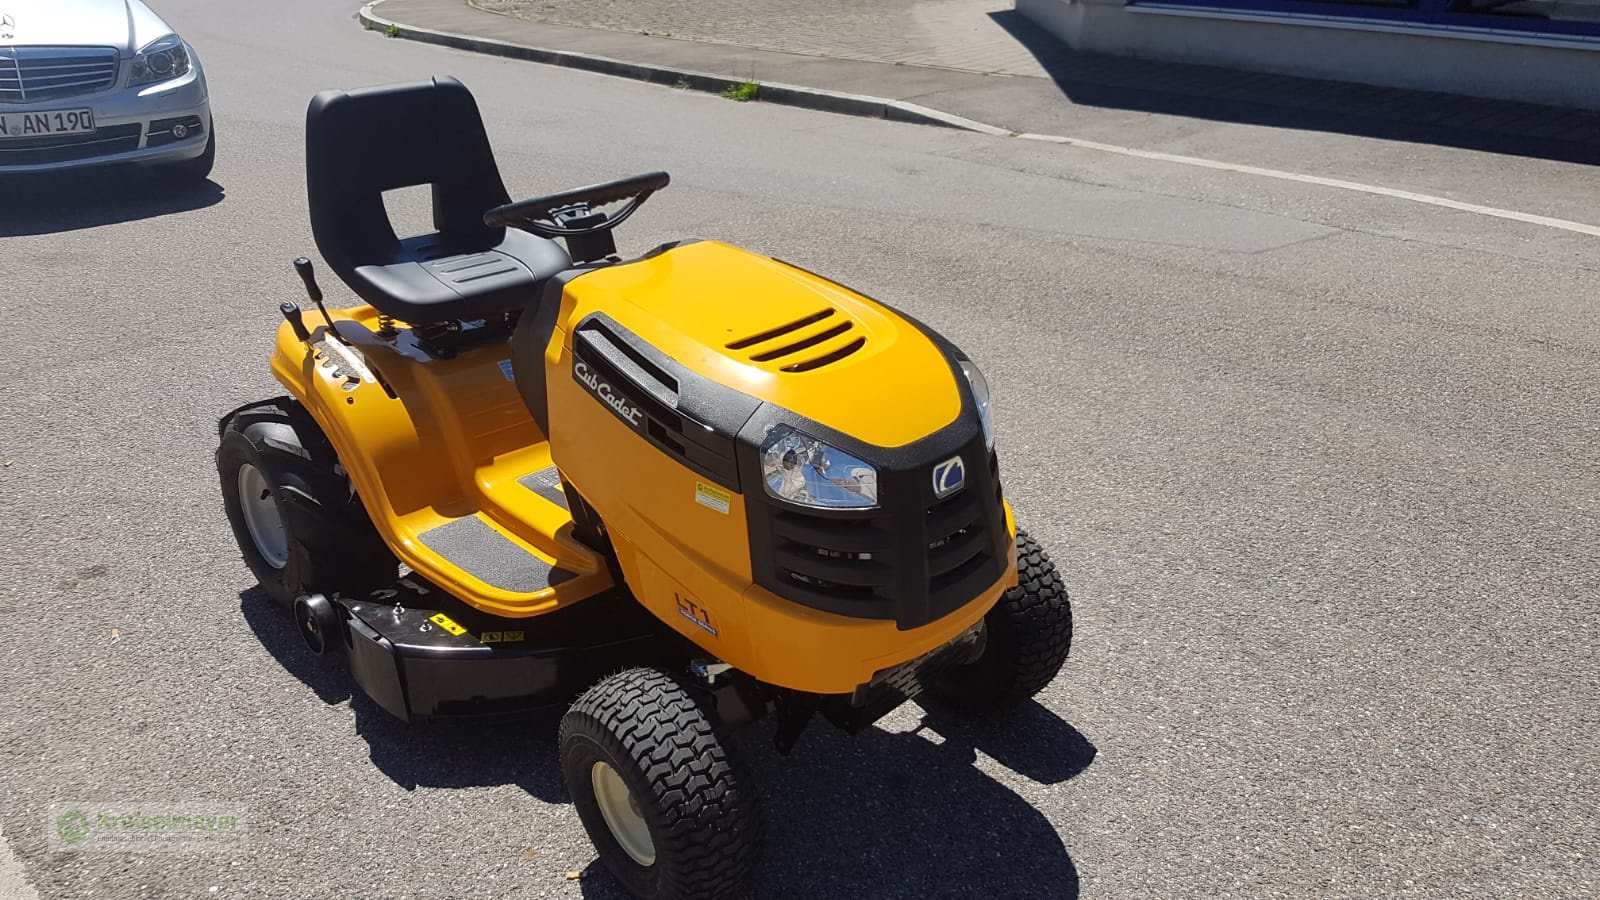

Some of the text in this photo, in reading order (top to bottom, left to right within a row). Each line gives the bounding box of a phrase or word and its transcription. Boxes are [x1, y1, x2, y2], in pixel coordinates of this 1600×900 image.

[24, 113, 50, 134] AN
[54, 111, 92, 132] 190
[574, 362, 642, 426] Cub Cadet
